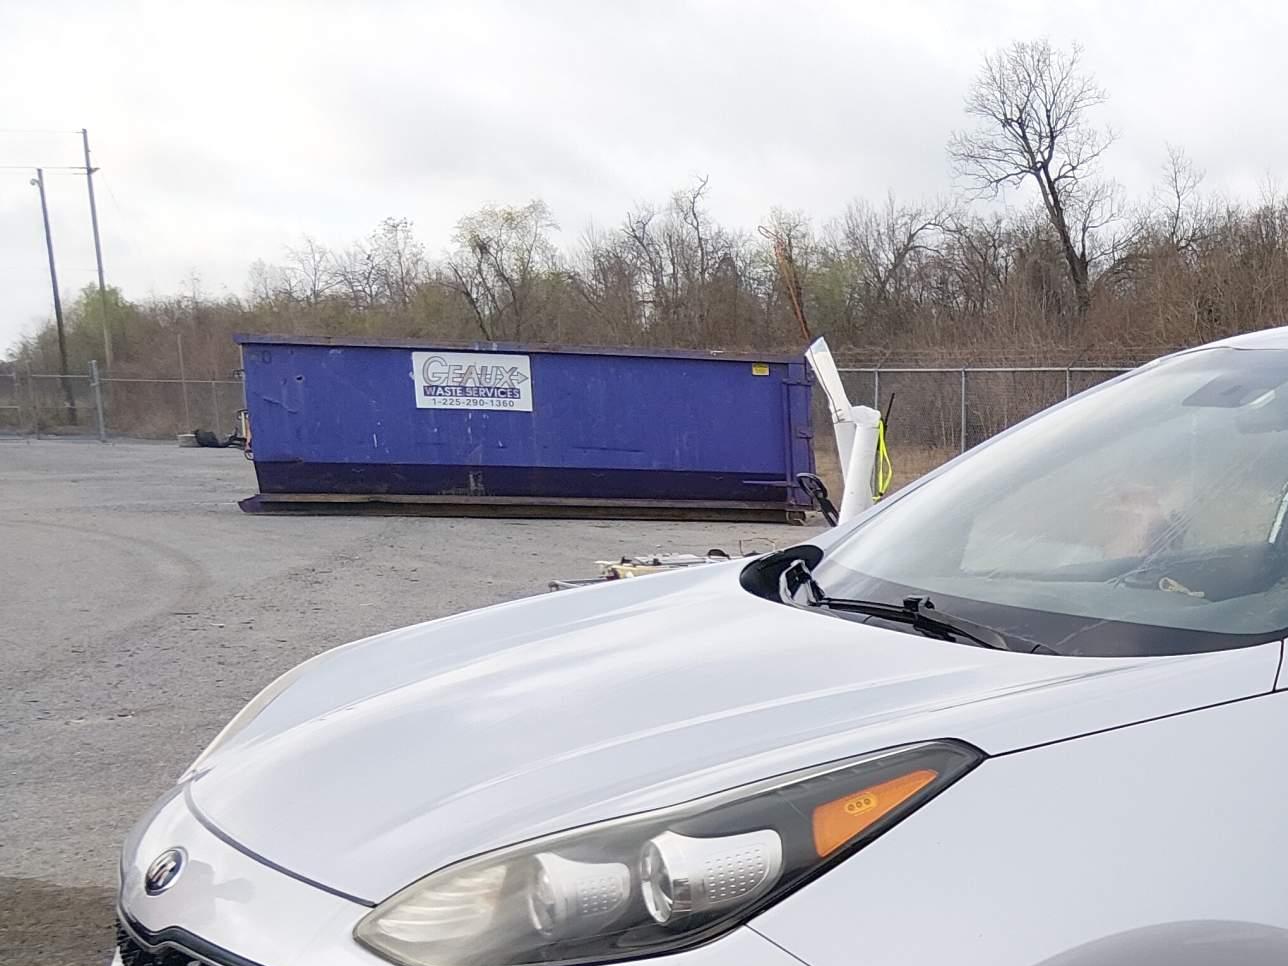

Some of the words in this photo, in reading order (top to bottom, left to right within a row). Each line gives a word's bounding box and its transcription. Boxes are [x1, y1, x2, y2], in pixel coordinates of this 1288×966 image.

[422, 355, 519, 389] GEAUX
[424, 385, 463, 397] WASTE
[465, 386, 520, 398] SERVICES
[432, 398, 515, 408] 1-225-290-1360
